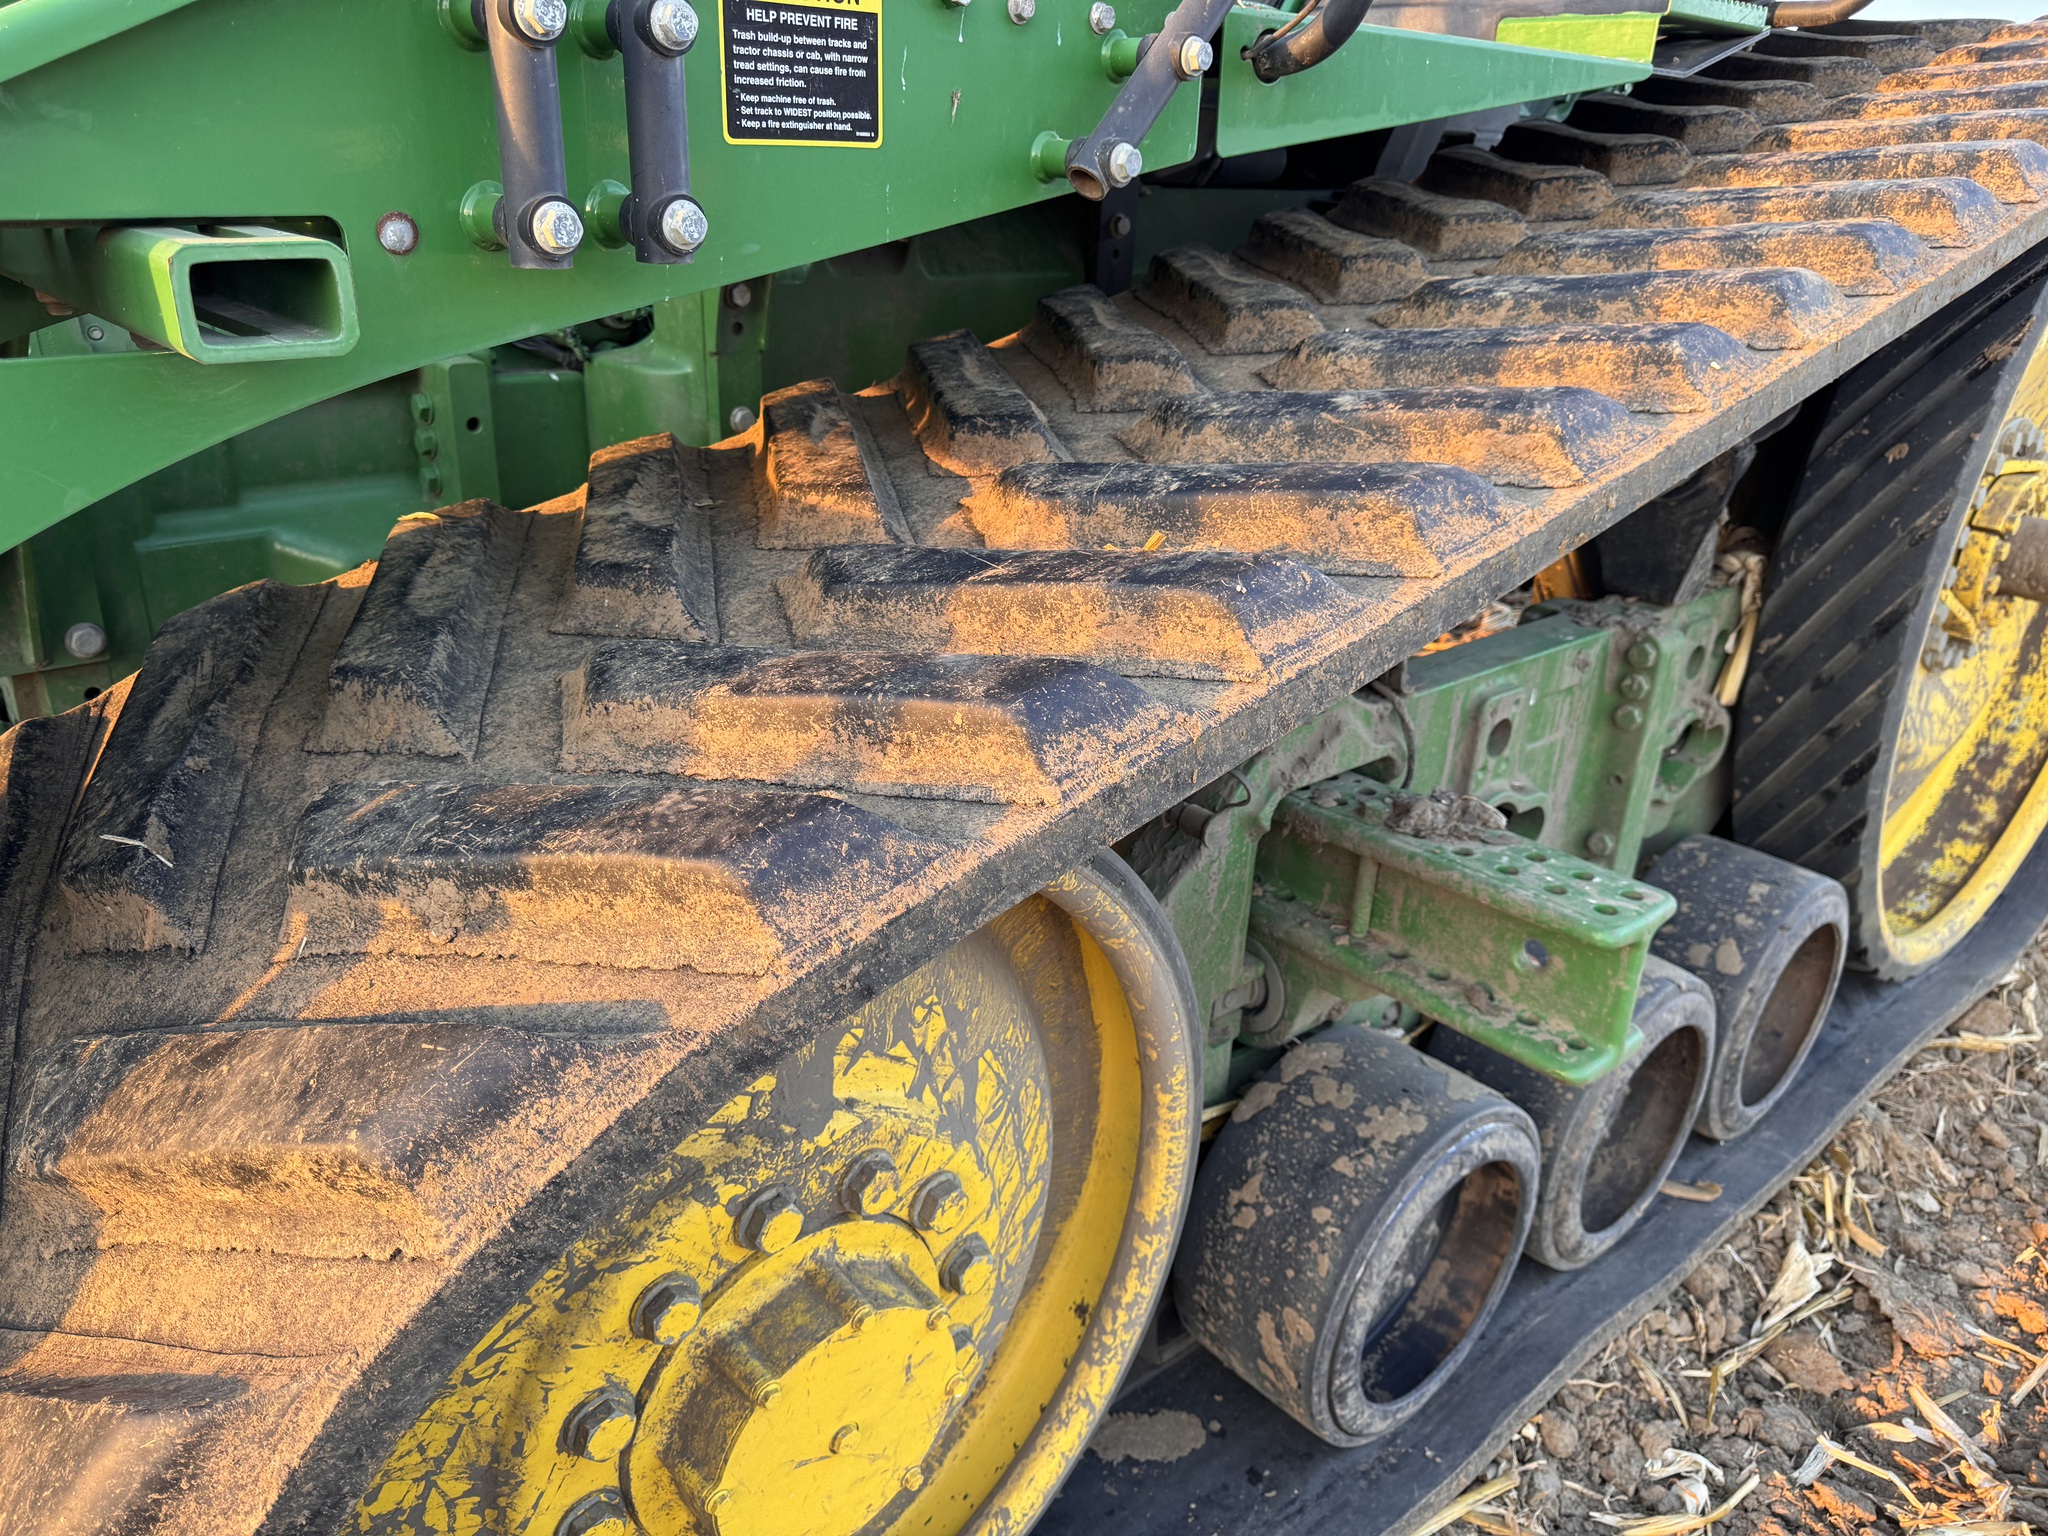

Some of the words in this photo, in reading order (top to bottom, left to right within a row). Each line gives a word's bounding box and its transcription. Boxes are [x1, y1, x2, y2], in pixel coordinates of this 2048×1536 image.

[747, 8, 777, 22] HELP
[780, 12, 831, 27] PREVENT
[834, 17, 858, 30] FIRE
[732, 29, 755, 40] Trash
[758, 31, 791, 45] build-up
[793, 34, 826, 46] between
[828, 37, 851, 48] tracks
[853, 40, 867, 49] and
[733, 45, 760, 55] tractor
[763, 47, 793, 58] chassis
[796, 50, 804, 59] or
[807, 51, 822, 62] cab,
[825, 52, 840, 62] with
[842, 54, 868, 63] narrow
[734, 60, 754, 70] tread
[757, 62, 791, 74] settings,
[794, 66, 808, 74] can
[810, 66, 833, 75] cause
[835, 67, 847, 76] fire
[849, 68, 866, 77] from
[734, 75, 774, 86] increased
[776, 76, 806, 88] friction.
[741, 93, 759, 103] Keep
[761, 94, 791, 104] machine
[793, 96, 806, 104] free
[808, 96, 815, 104] of
[817, 97, 836, 106] trash.
[741, 106, 753, 115] Set
[755, 107, 773, 116] track
[784, 108, 812, 117] WIDEST
[814, 110, 840, 120] position
[842, 111, 872, 120] possible.
[742, 119, 760, 128] Keep
[768, 120, 780, 128] fire
[782, 121, 824, 131] extinguisher
[834, 122, 852, 131] hand.
